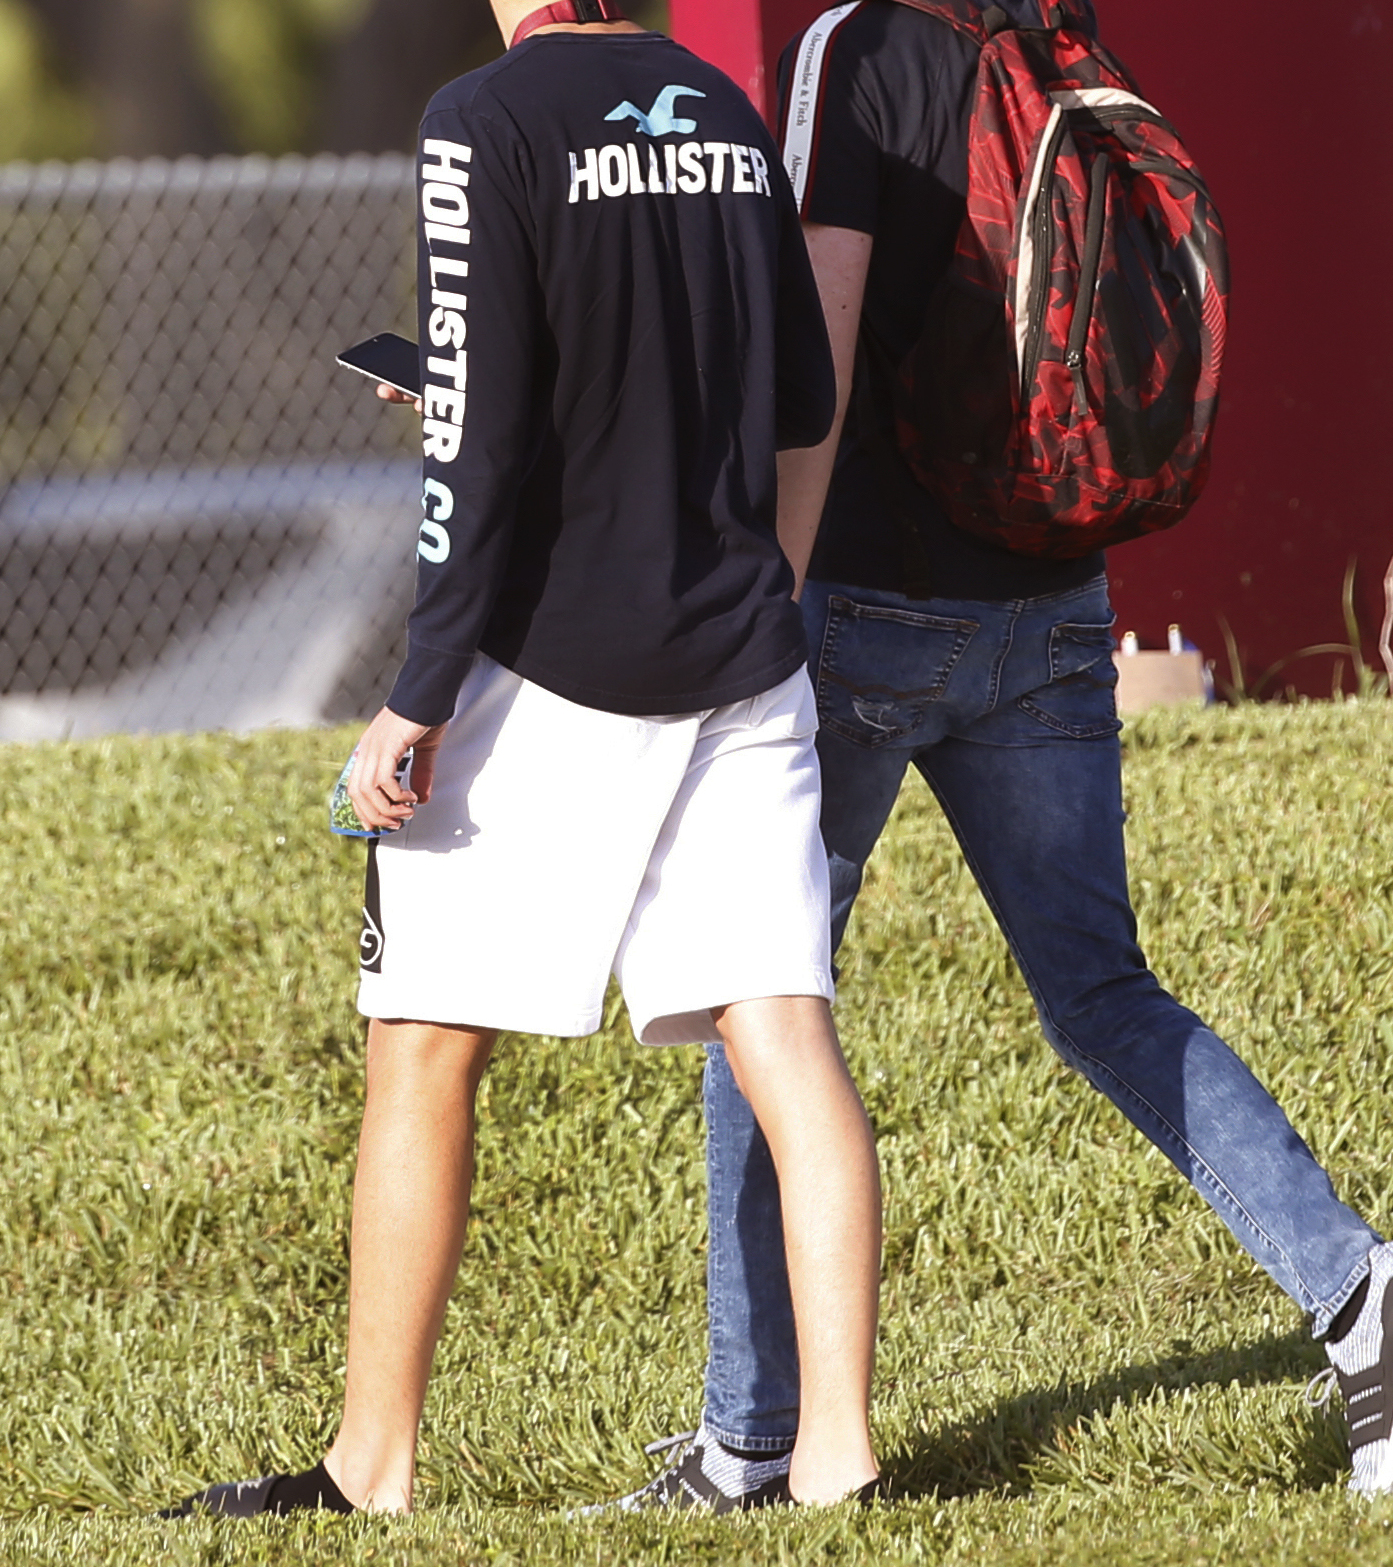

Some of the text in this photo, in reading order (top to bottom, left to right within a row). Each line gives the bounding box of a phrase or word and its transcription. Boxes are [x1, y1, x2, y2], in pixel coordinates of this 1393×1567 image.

[801, 31, 823, 86] Abercrombie
[795, 101, 810, 127] Fitch
[568, 141, 772, 204] HOLLISTER
[421, 137, 473, 464] HOLLISTER
